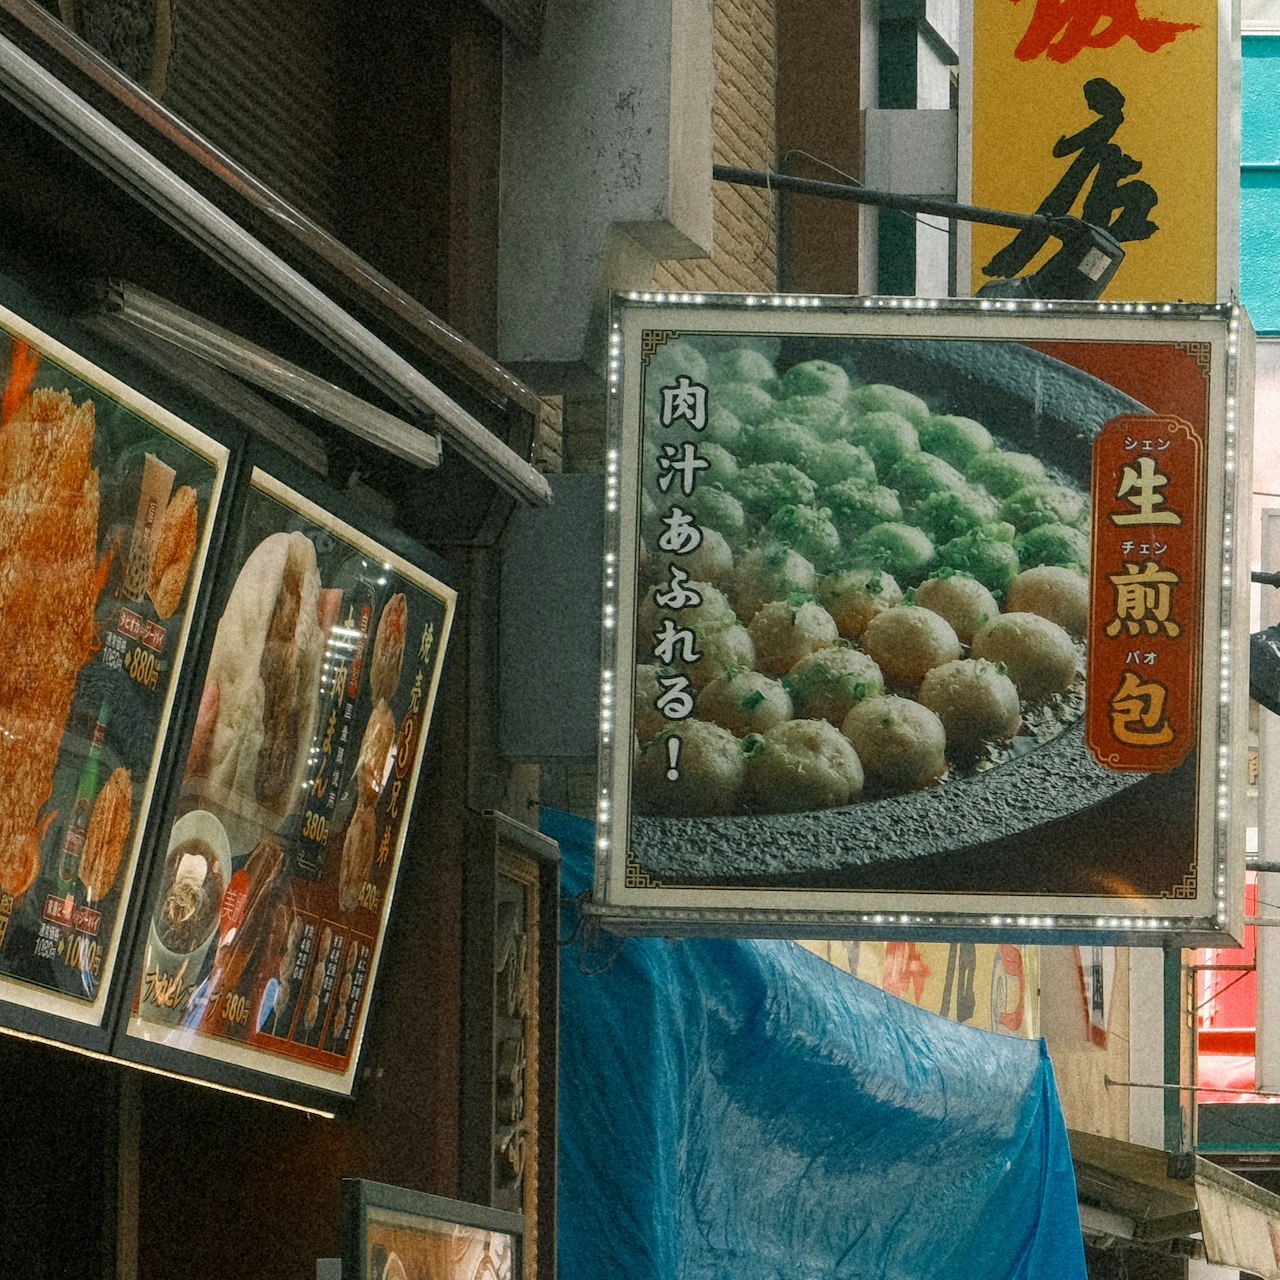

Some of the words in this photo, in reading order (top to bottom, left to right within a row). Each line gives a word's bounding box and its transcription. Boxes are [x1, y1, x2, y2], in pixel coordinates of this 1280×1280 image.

[1123, 435, 1171, 452] シェン
[1120, 540, 1168, 557] チェン
[1105, 458, 1182, 746] 生煎包
[1125, 650, 1157, 665] パオ
